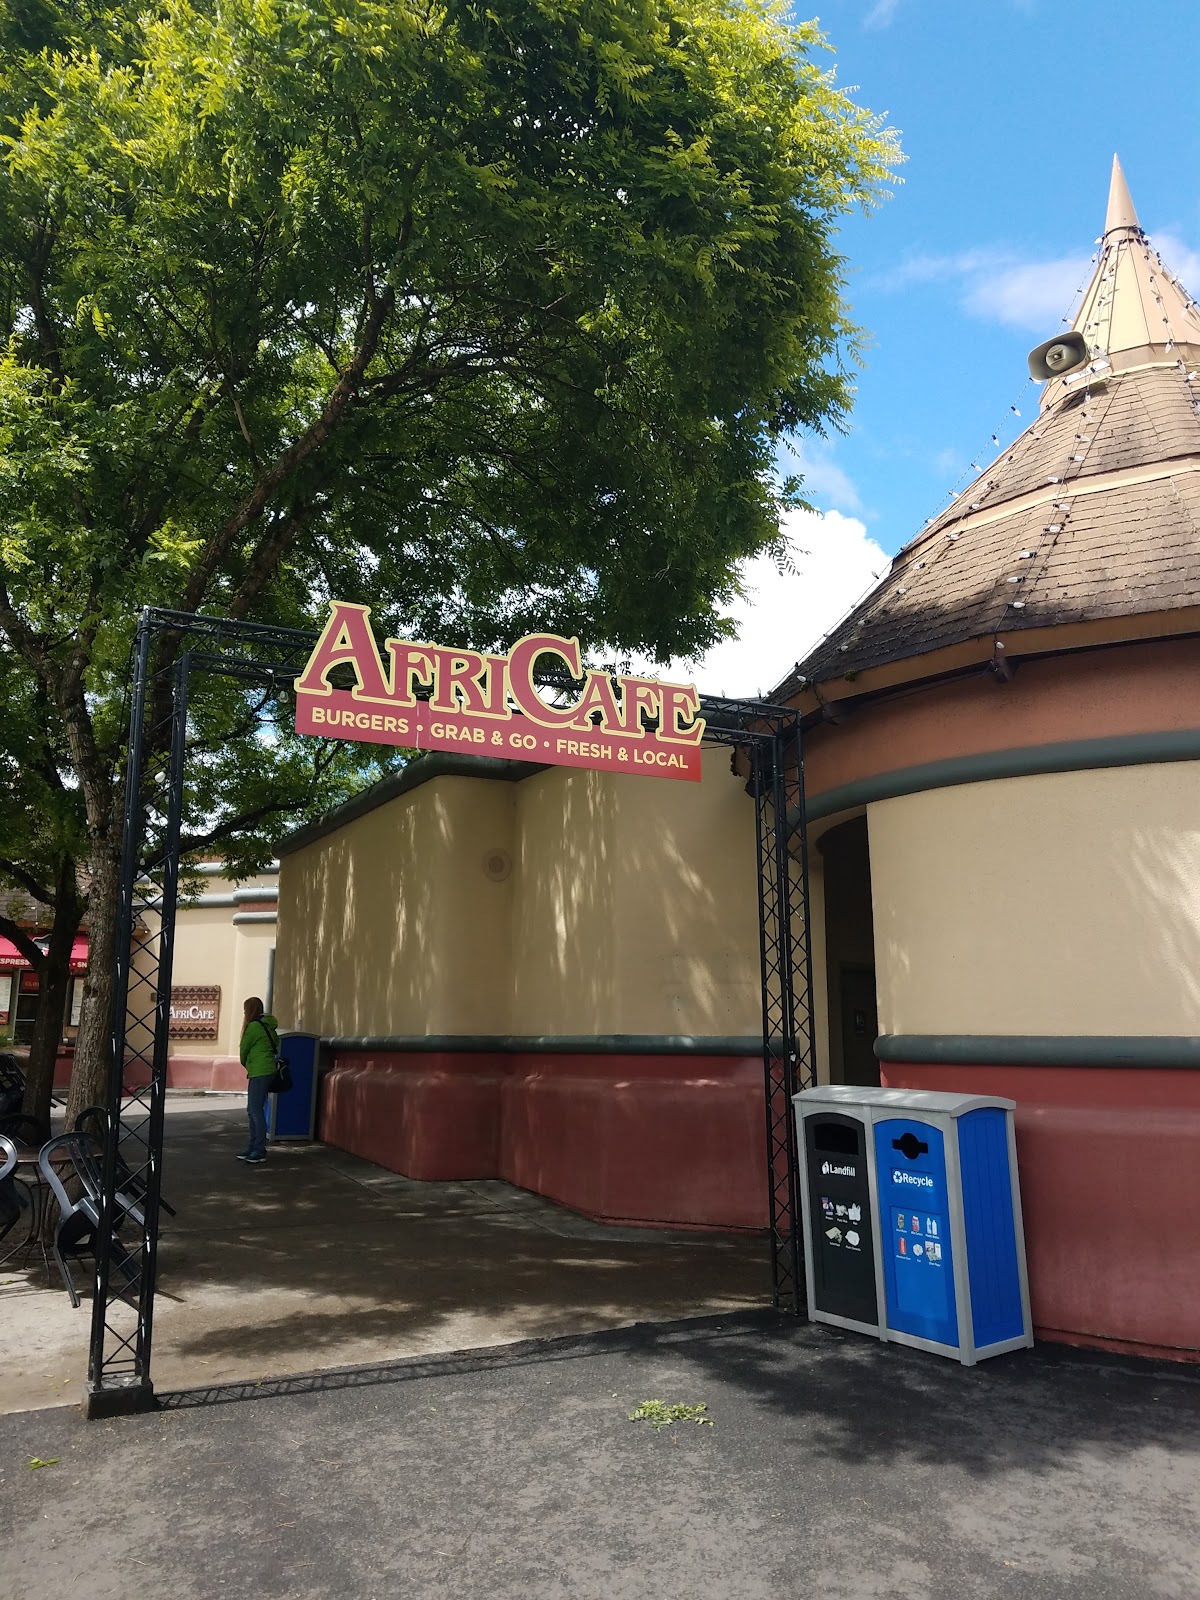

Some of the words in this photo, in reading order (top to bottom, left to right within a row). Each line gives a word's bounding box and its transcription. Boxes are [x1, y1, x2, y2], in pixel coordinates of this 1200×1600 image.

[311, 706, 409, 734] BURGERS
[430, 722, 486, 744] GRAB
[490, 730, 504, 746] &
[509, 732, 537, 750] GO
[556, 738, 612, 760] FRESH
[617, 747, 629, 762] &
[633, 748, 689, 769] LOCAL
[0, 957, 31, 966] SPRESS
[829, 1163, 856, 1177] Landfill
[902, 1172, 934, 1187] Recycle
